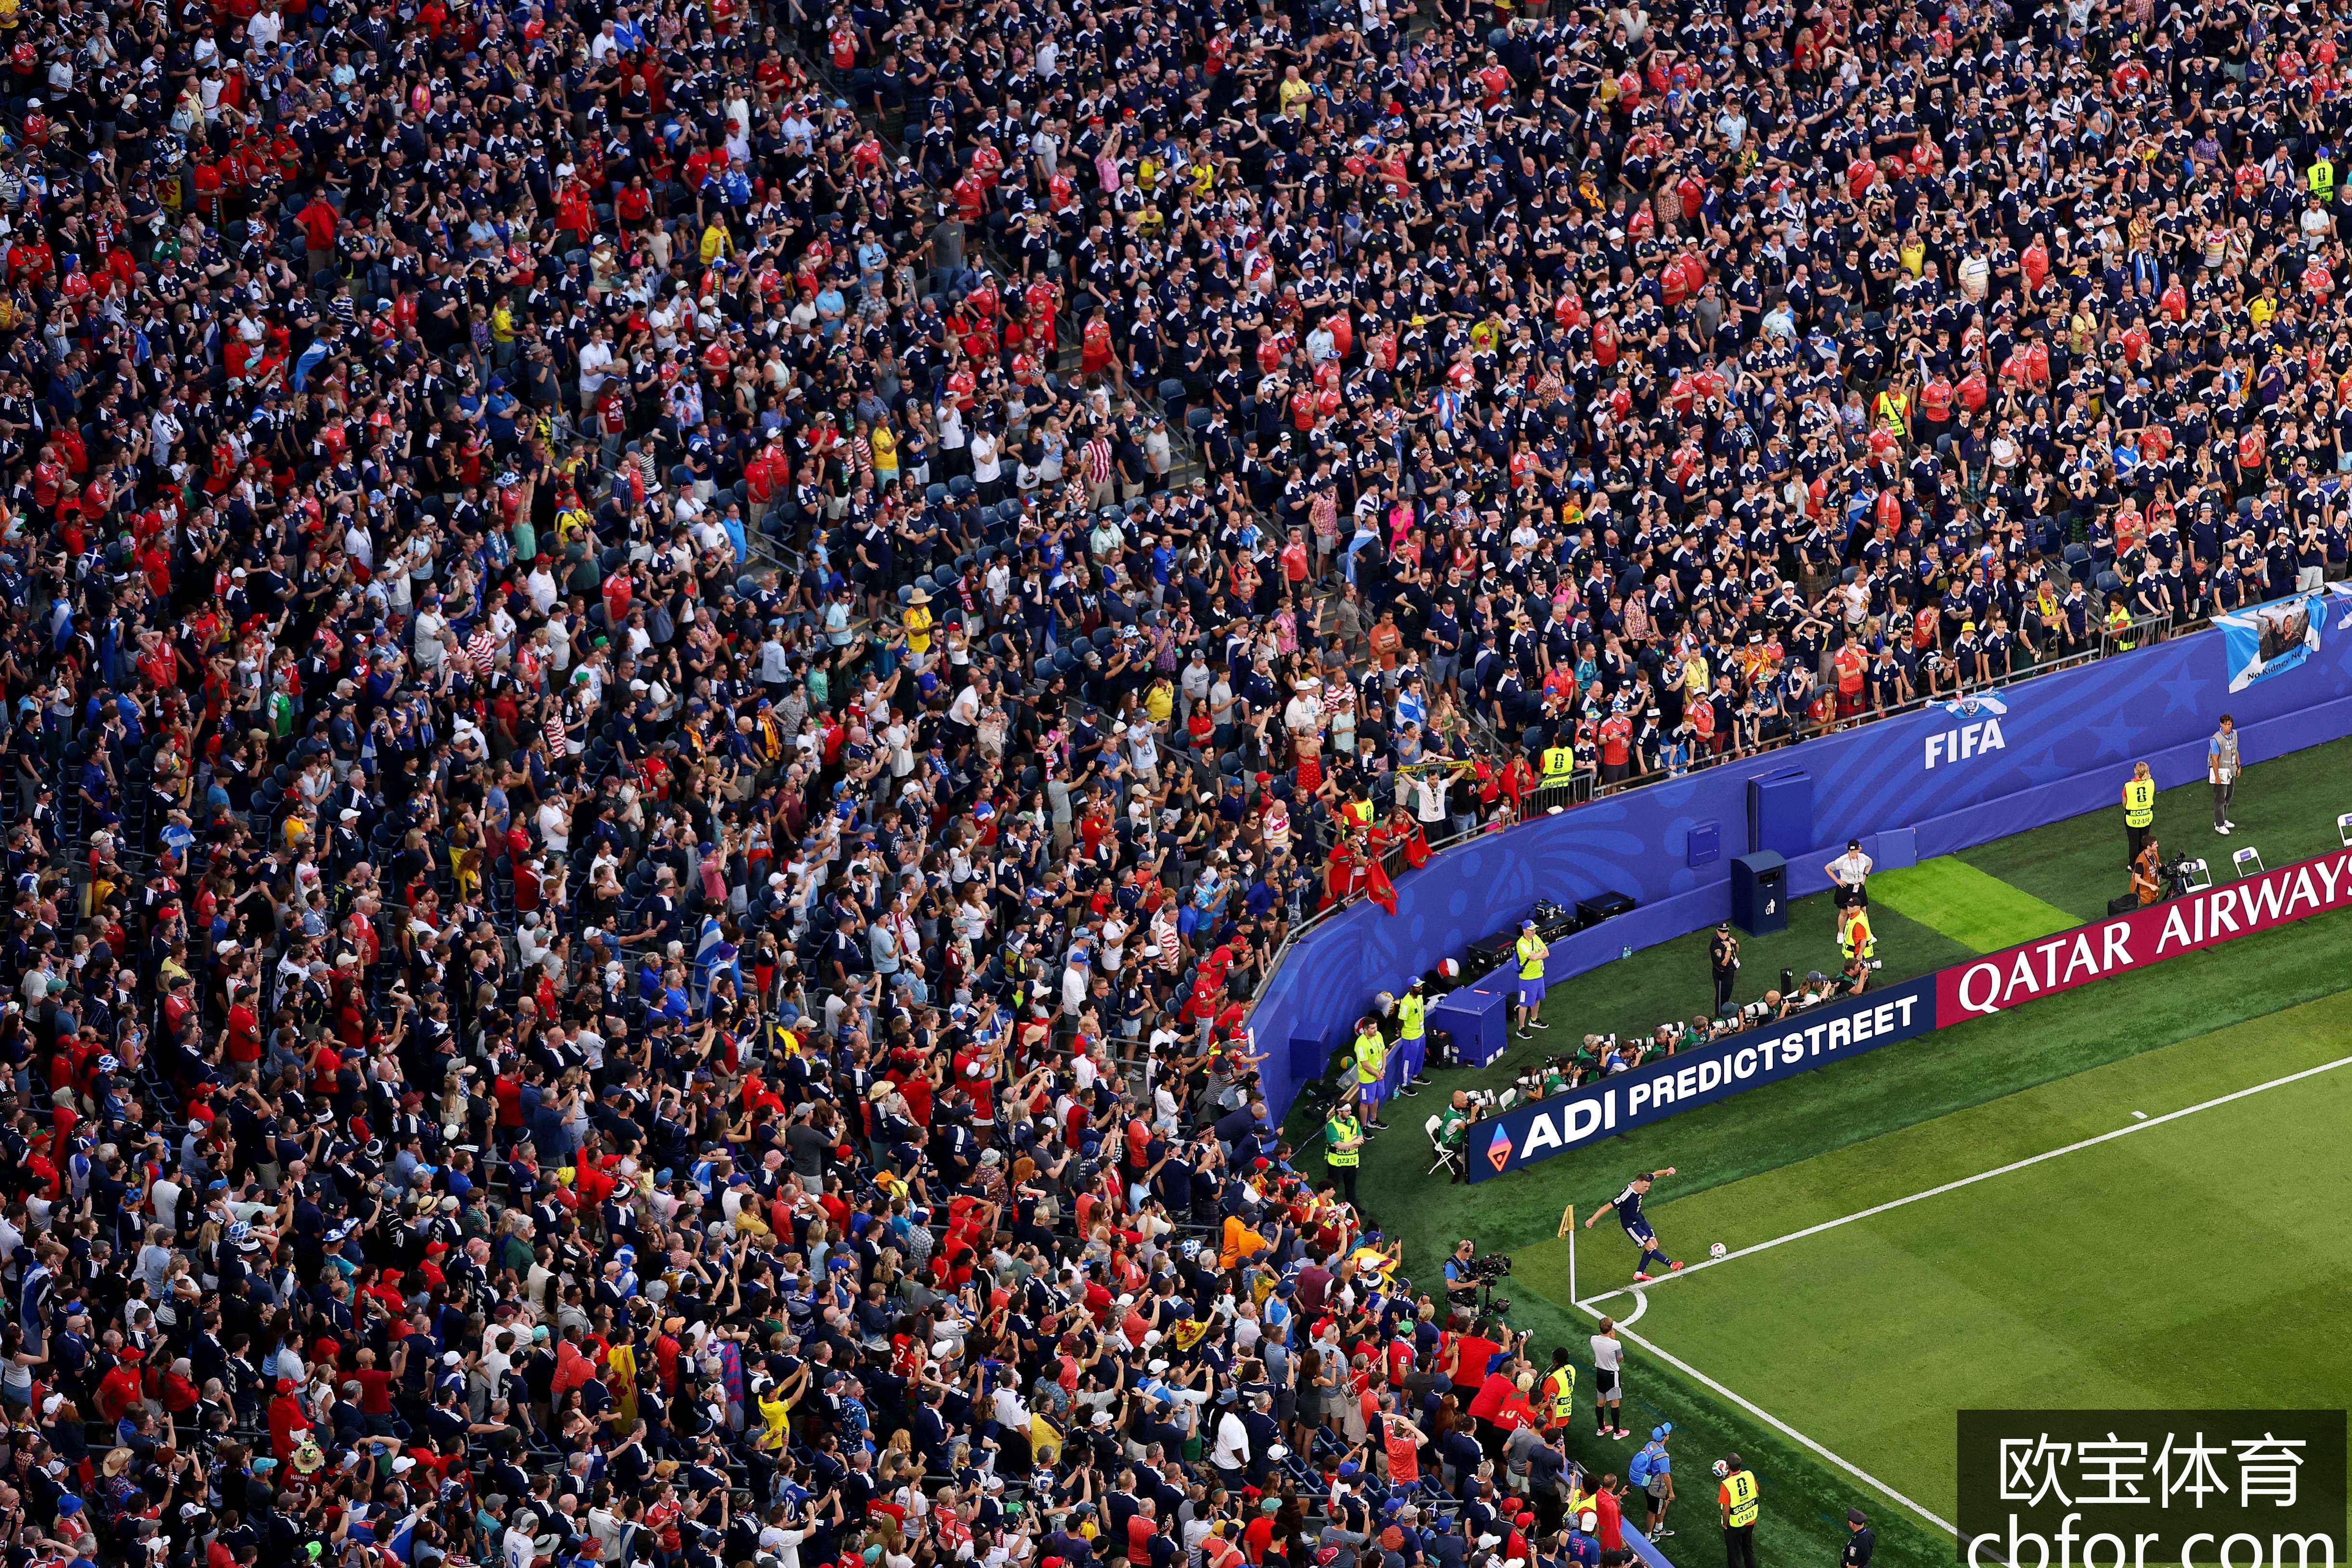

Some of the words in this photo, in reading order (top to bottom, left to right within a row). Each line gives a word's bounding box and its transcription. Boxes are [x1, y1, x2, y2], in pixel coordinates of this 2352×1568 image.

[2248, 672, 2260, 680] No
[2262, 657, 2289, 676] Kidney
[1925, 719, 2005, 769] FIFA
[1959, 921, 2134, 1013] QATAR
[2156, 855, 2352, 954] AIRWAY
[1520, 1089, 1615, 1159] ADI
[1629, 995, 1918, 1116] PREDICTSTREET
[898, 1349, 904, 1363] 2
[786, 1497, 795, 1520] 10
[1733, 1499, 1755, 1515] SECURITY
